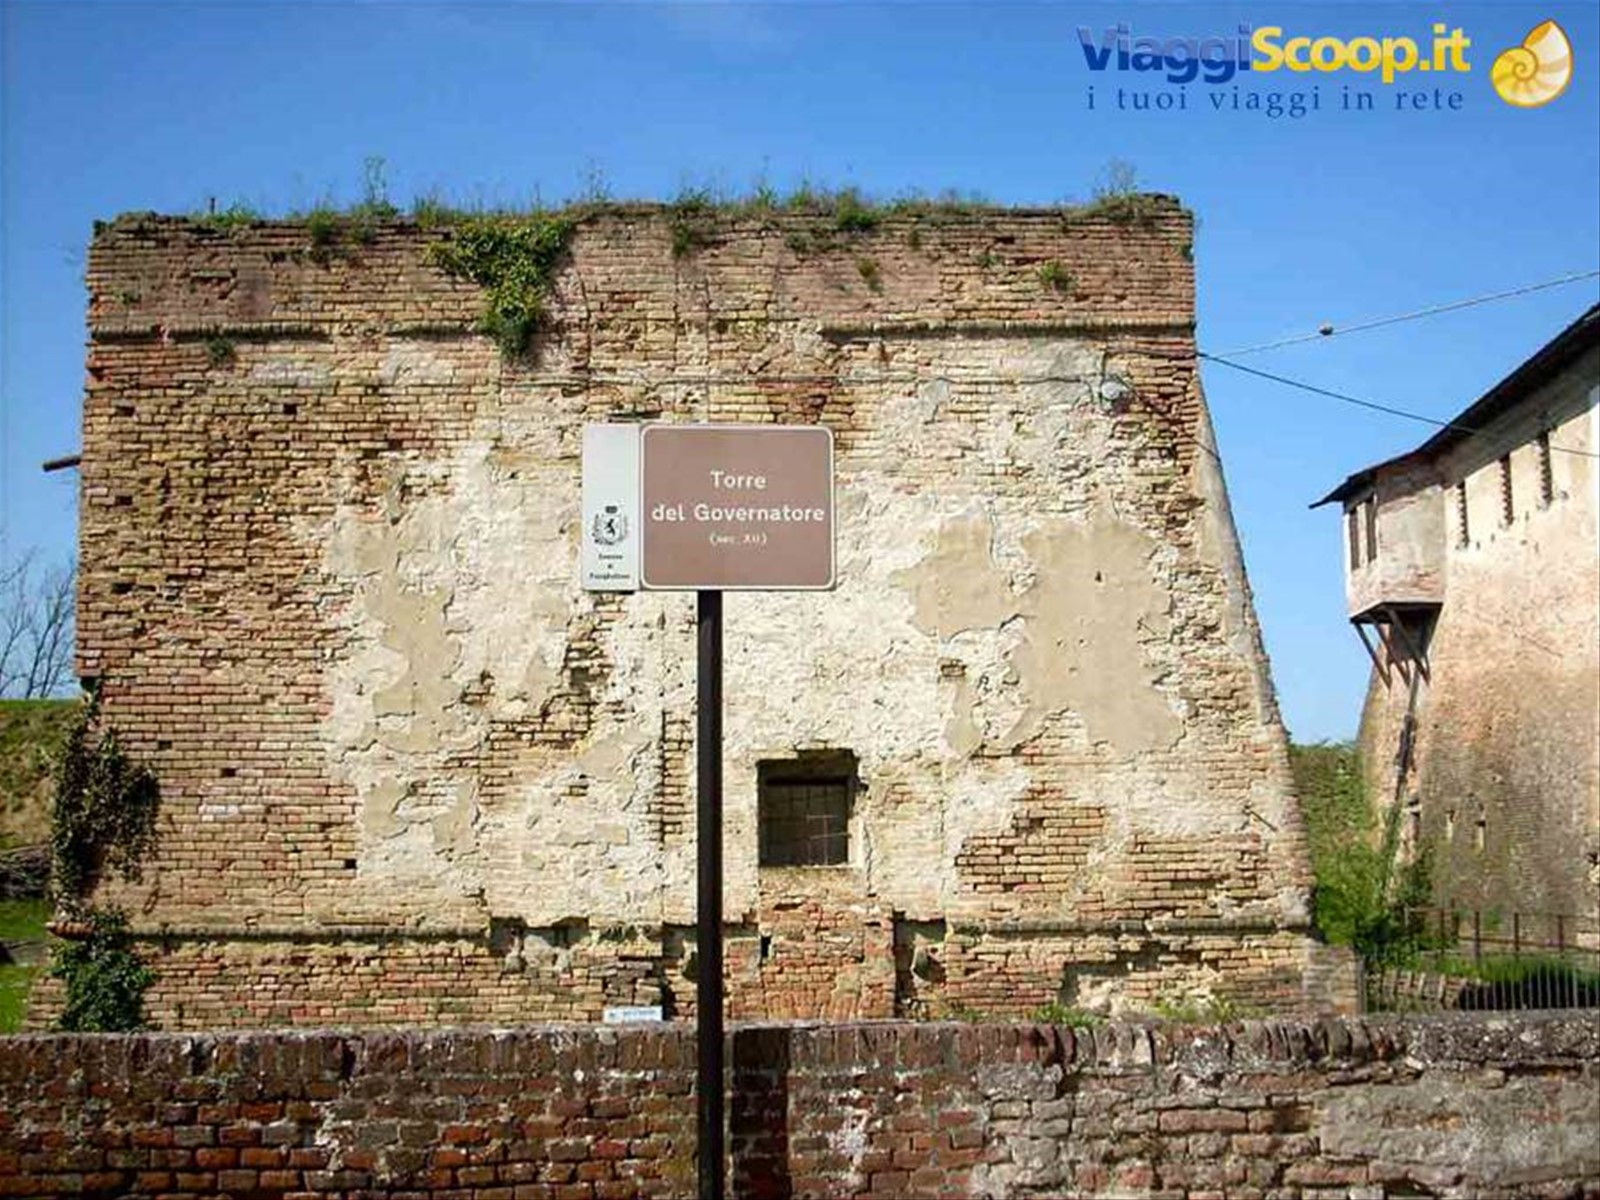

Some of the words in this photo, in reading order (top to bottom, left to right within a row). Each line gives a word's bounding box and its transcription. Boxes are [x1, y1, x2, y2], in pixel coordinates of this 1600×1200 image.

[710, 471, 767, 489] Torre
[652, 504, 685, 522] del
[694, 504, 825, 522] Governatore
